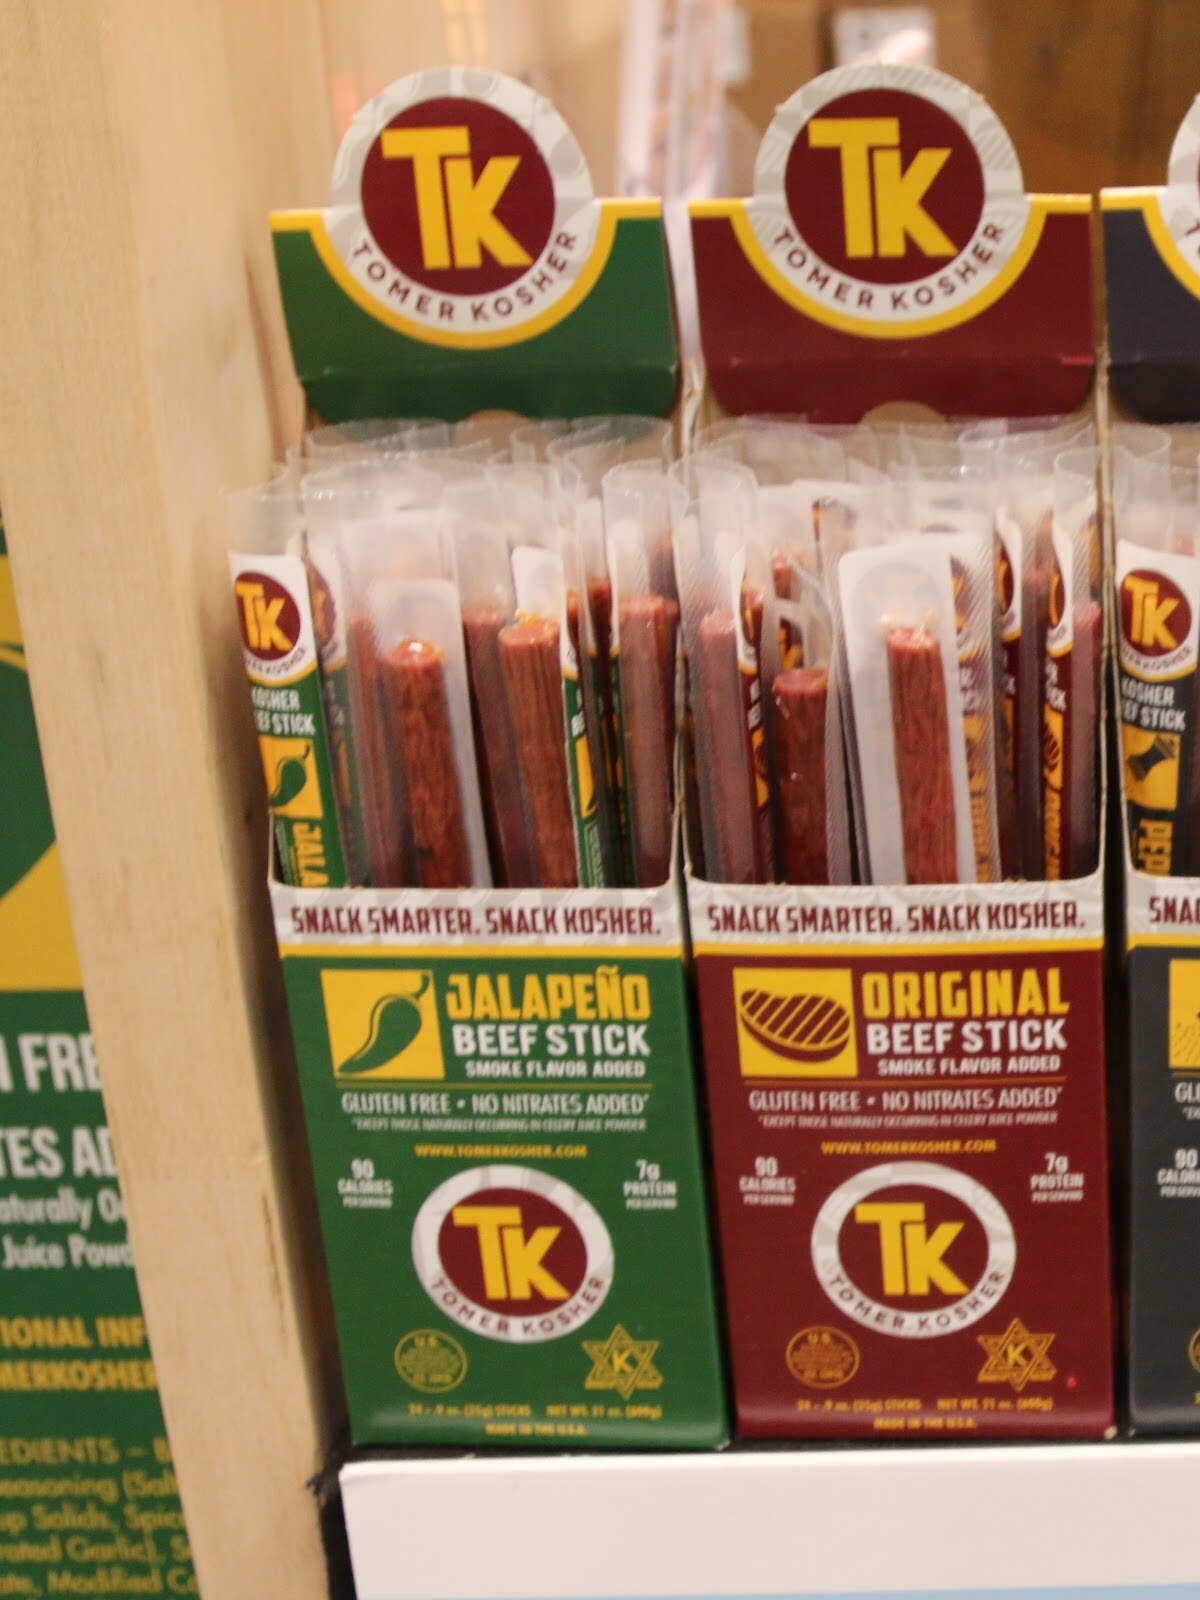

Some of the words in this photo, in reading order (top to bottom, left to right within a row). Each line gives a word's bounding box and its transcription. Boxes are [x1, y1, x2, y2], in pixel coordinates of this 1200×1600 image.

[355, 241, 454, 319] TOMER
[471, 231, 576, 321] KOSHER
[775, 228, 874, 309] TOMER
[890, 223, 1003, 311] KOSHER
[1140, 706, 1186, 732] STICK
[292, 907, 362, 935] SNACK
[369, 908, 480, 935] SMARTER.
[486, 908, 558, 935] SNACK
[565, 908, 661, 935] KOSHER.
[708, 906, 780, 933] SNACK
[787, 906, 900, 933] SMARTER.
[907, 904, 979, 932] SNACK
[988, 900, 1086, 930] KOSHER.
[446, 965, 651, 1021] JALAPEÑO
[862, 967, 1070, 1019] ORIGINAL
[453, 1024, 538, 1056] BEEF
[546, 1024, 651, 1056] STICK
[867, 1022, 953, 1055] BEEF
[962, 1019, 1067, 1051] STICK
[466, 1061, 521, 1078] SMOKE
[526, 1061, 588, 1078] FLAVOR
[593, 1061, 645, 1078] ADDED
[878, 1059, 934, 1076] SMOKE
[940, 1058, 1001, 1075] FLAVOR
[1008, 1055, 1060, 1073] ADDED
[342, 1094, 406, 1114] GLUTEN
[410, 1094, 449, 1114] FREE
[472, 1094, 498, 1114] NO
[503, 1094, 582, 1114] NITRATES
[749, 1091, 814, 1112] GLUTEN
[819, 1091, 860, 1112] FREE
[883, 1090, 907, 1111] NO
[913, 1089, 993, 1111] NITRATES
[352, 1160, 373, 1179] 90
[636, 1160, 660, 1179] 7g
[755, 1157, 777, 1177] 90
[1045, 1153, 1068, 1173] 7g
[1175, 1149, 1198, 1168] 90
[623, 1182, 676, 1197] PROTEIN
[1031, 1173, 1084, 1190] PROTEIN
[432, 1279, 509, 1332] TOMER
[521, 1277, 604, 1334] KOSHER
[828, 1275, 905, 1329] TOMER
[918, 1271, 1005, 1331] KOSHER
[612, 1350, 633, 1373] K
[1006, 1344, 1027, 1366] K
